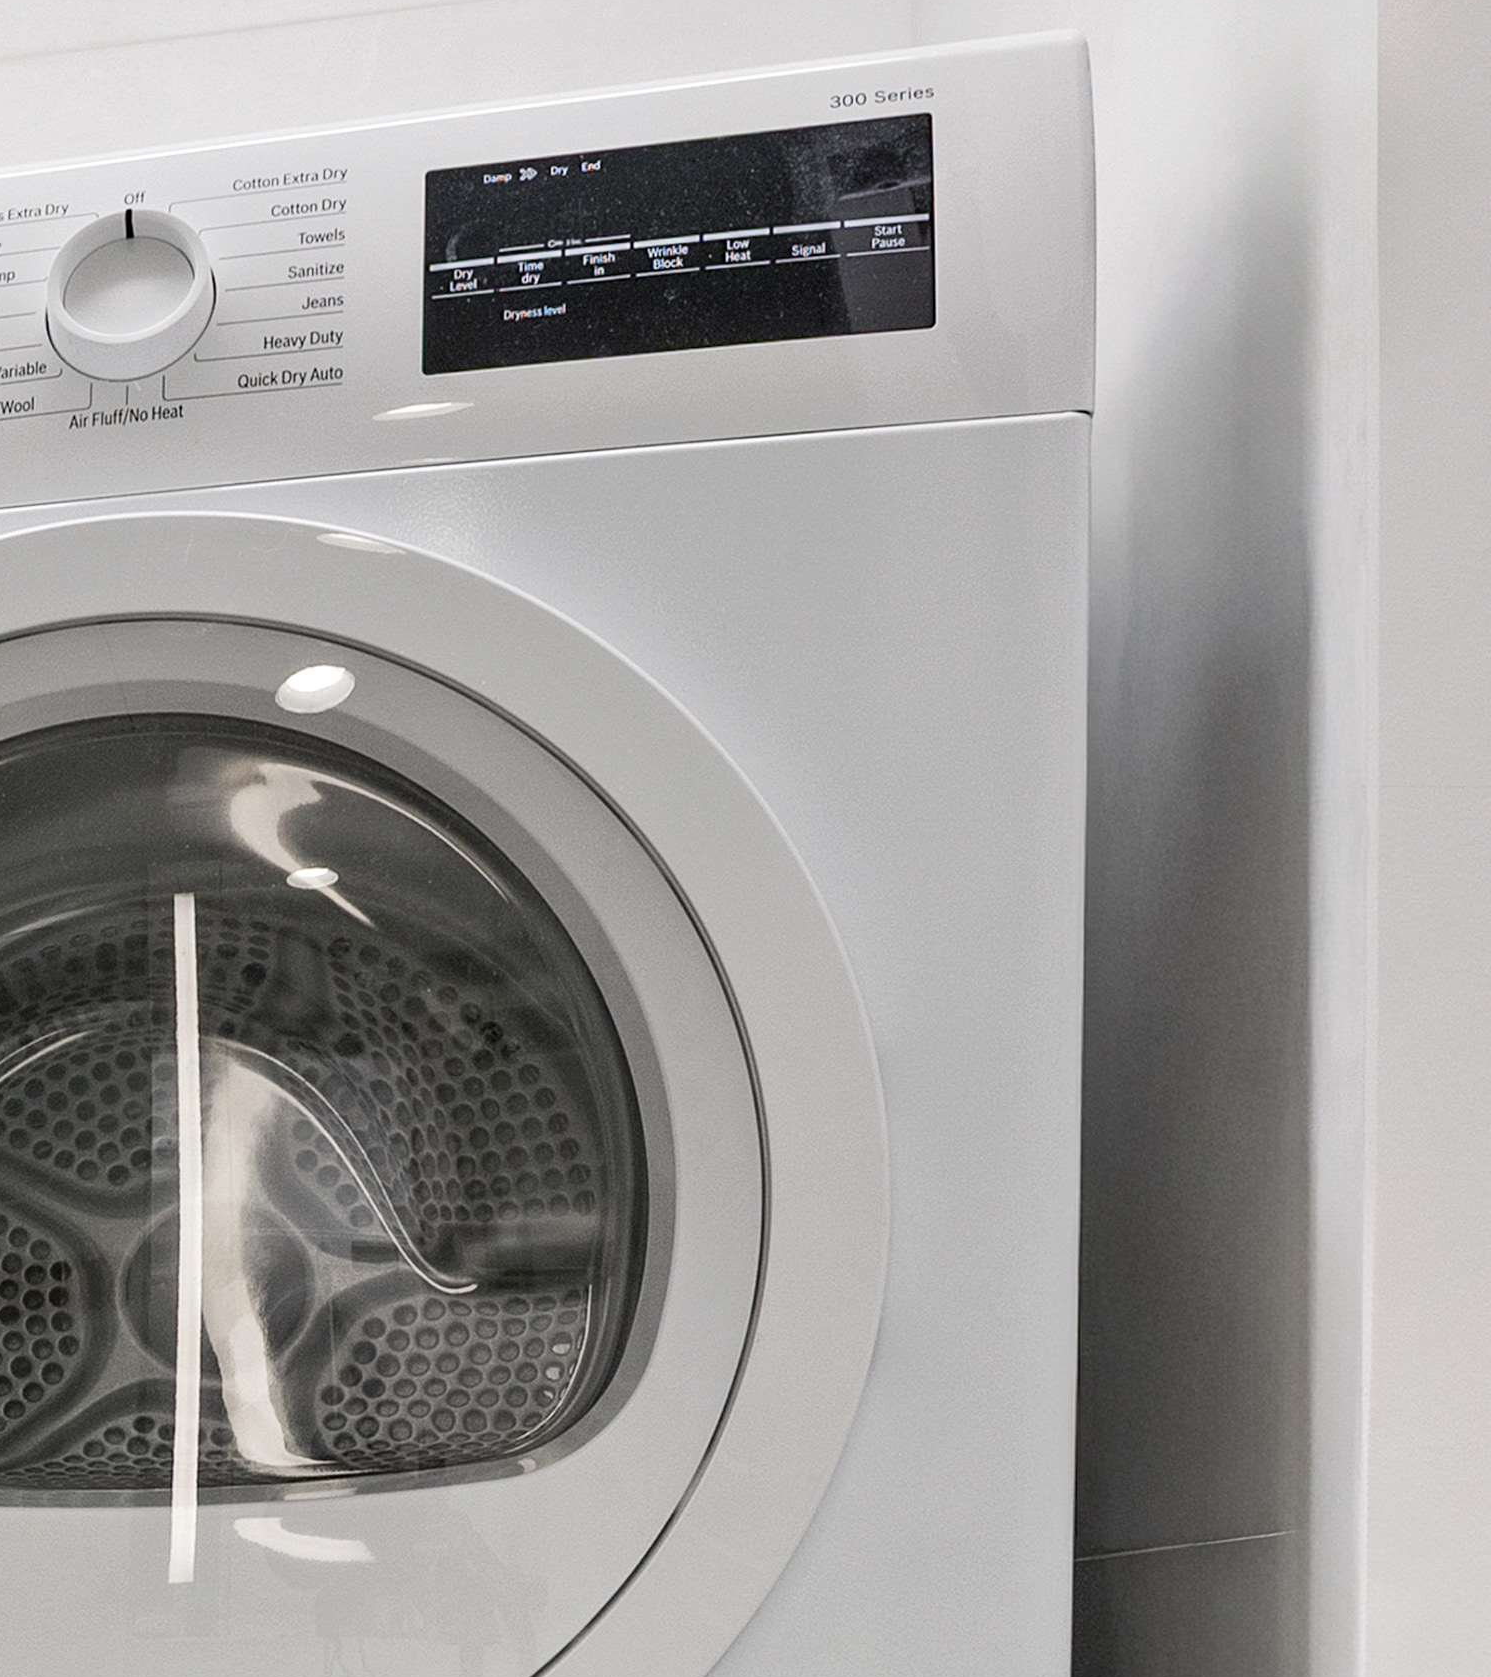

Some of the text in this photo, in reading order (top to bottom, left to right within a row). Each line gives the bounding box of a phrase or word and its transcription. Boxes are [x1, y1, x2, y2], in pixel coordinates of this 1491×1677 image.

[830, 86, 935, 108] 300 Series
[233, 168, 348, 190] Cotton Extra Dry
[484, 161, 601, 184] Damp Dry End
[124, 192, 144, 204] Off
[8, 209, 41, 220] Extra
[46, 204, 68, 218] Dry
[272, 198, 346, 217] Cotton Dry
[298, 229, 345, 244] Towels
[874, 225, 902, 235] Start
[727, 240, 749, 250] Low
[792, 242, 826, 257] Signal
[872, 237, 905, 248] Pause
[648, 245, 688, 258] Wrinkle
[725, 251, 750, 262] Heat
[583, 253, 615, 265] Finish
[653, 257, 683, 269] Block
[288, 263, 344, 278] Sanitize
[518, 261, 544, 272] Time
[594, 266, 604, 276] in
[454, 269, 473, 281] Dry
[522, 273, 540, 285] dry
[450, 279, 477, 292] Level
[302, 295, 344, 310] Jeans
[504, 304, 566, 321] Dryness level
[263, 330, 343, 350] Heavy Duty
[238, 366, 343, 389] Quick Dry Auto
[69, 405, 183, 429] Air Fluff/No Heat
